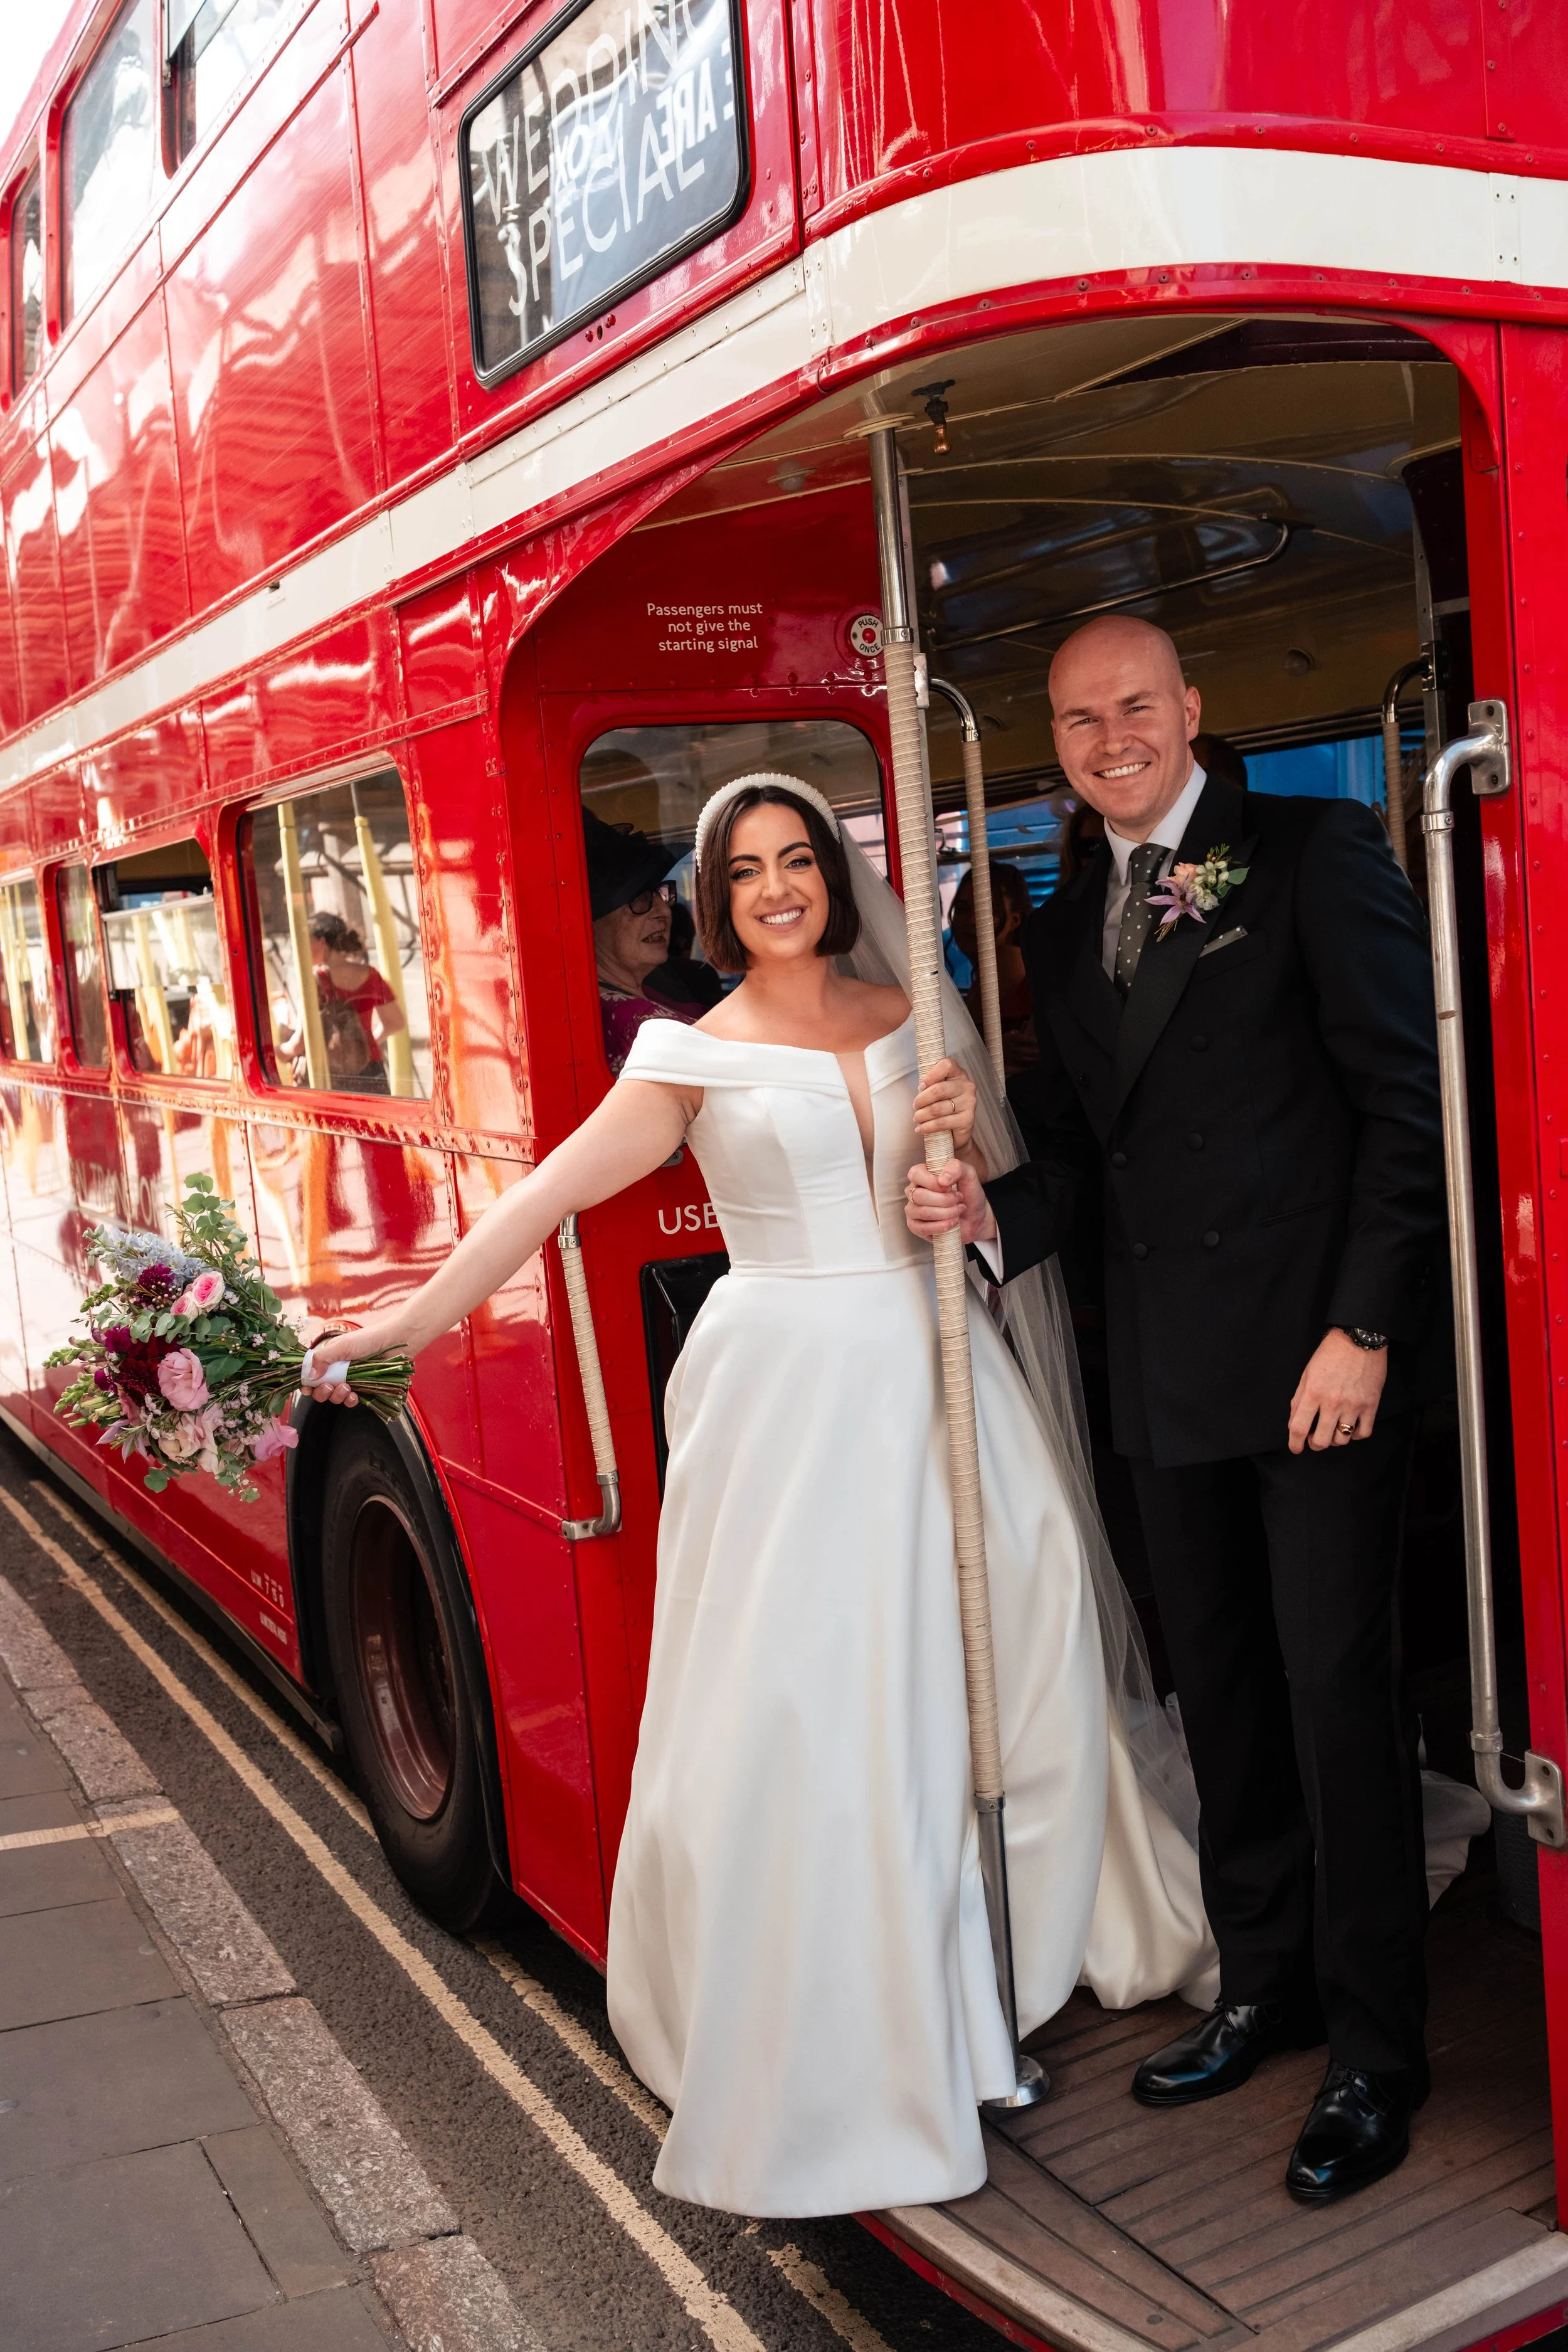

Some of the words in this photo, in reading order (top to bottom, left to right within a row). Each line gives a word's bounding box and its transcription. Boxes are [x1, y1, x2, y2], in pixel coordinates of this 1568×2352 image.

[509, 93, 705, 315] SPECIAL
[647, 603, 724, 618] Passengers
[728, 603, 763, 615] must
[668, 621, 692, 633] not
[696, 620, 724, 635] give
[728, 618, 751, 632] the
[858, 618, 879, 628] PUSH
[659, 638, 715, 653] starting
[718, 635, 758, 652] signal
[859, 643, 881, 653] ONCE
